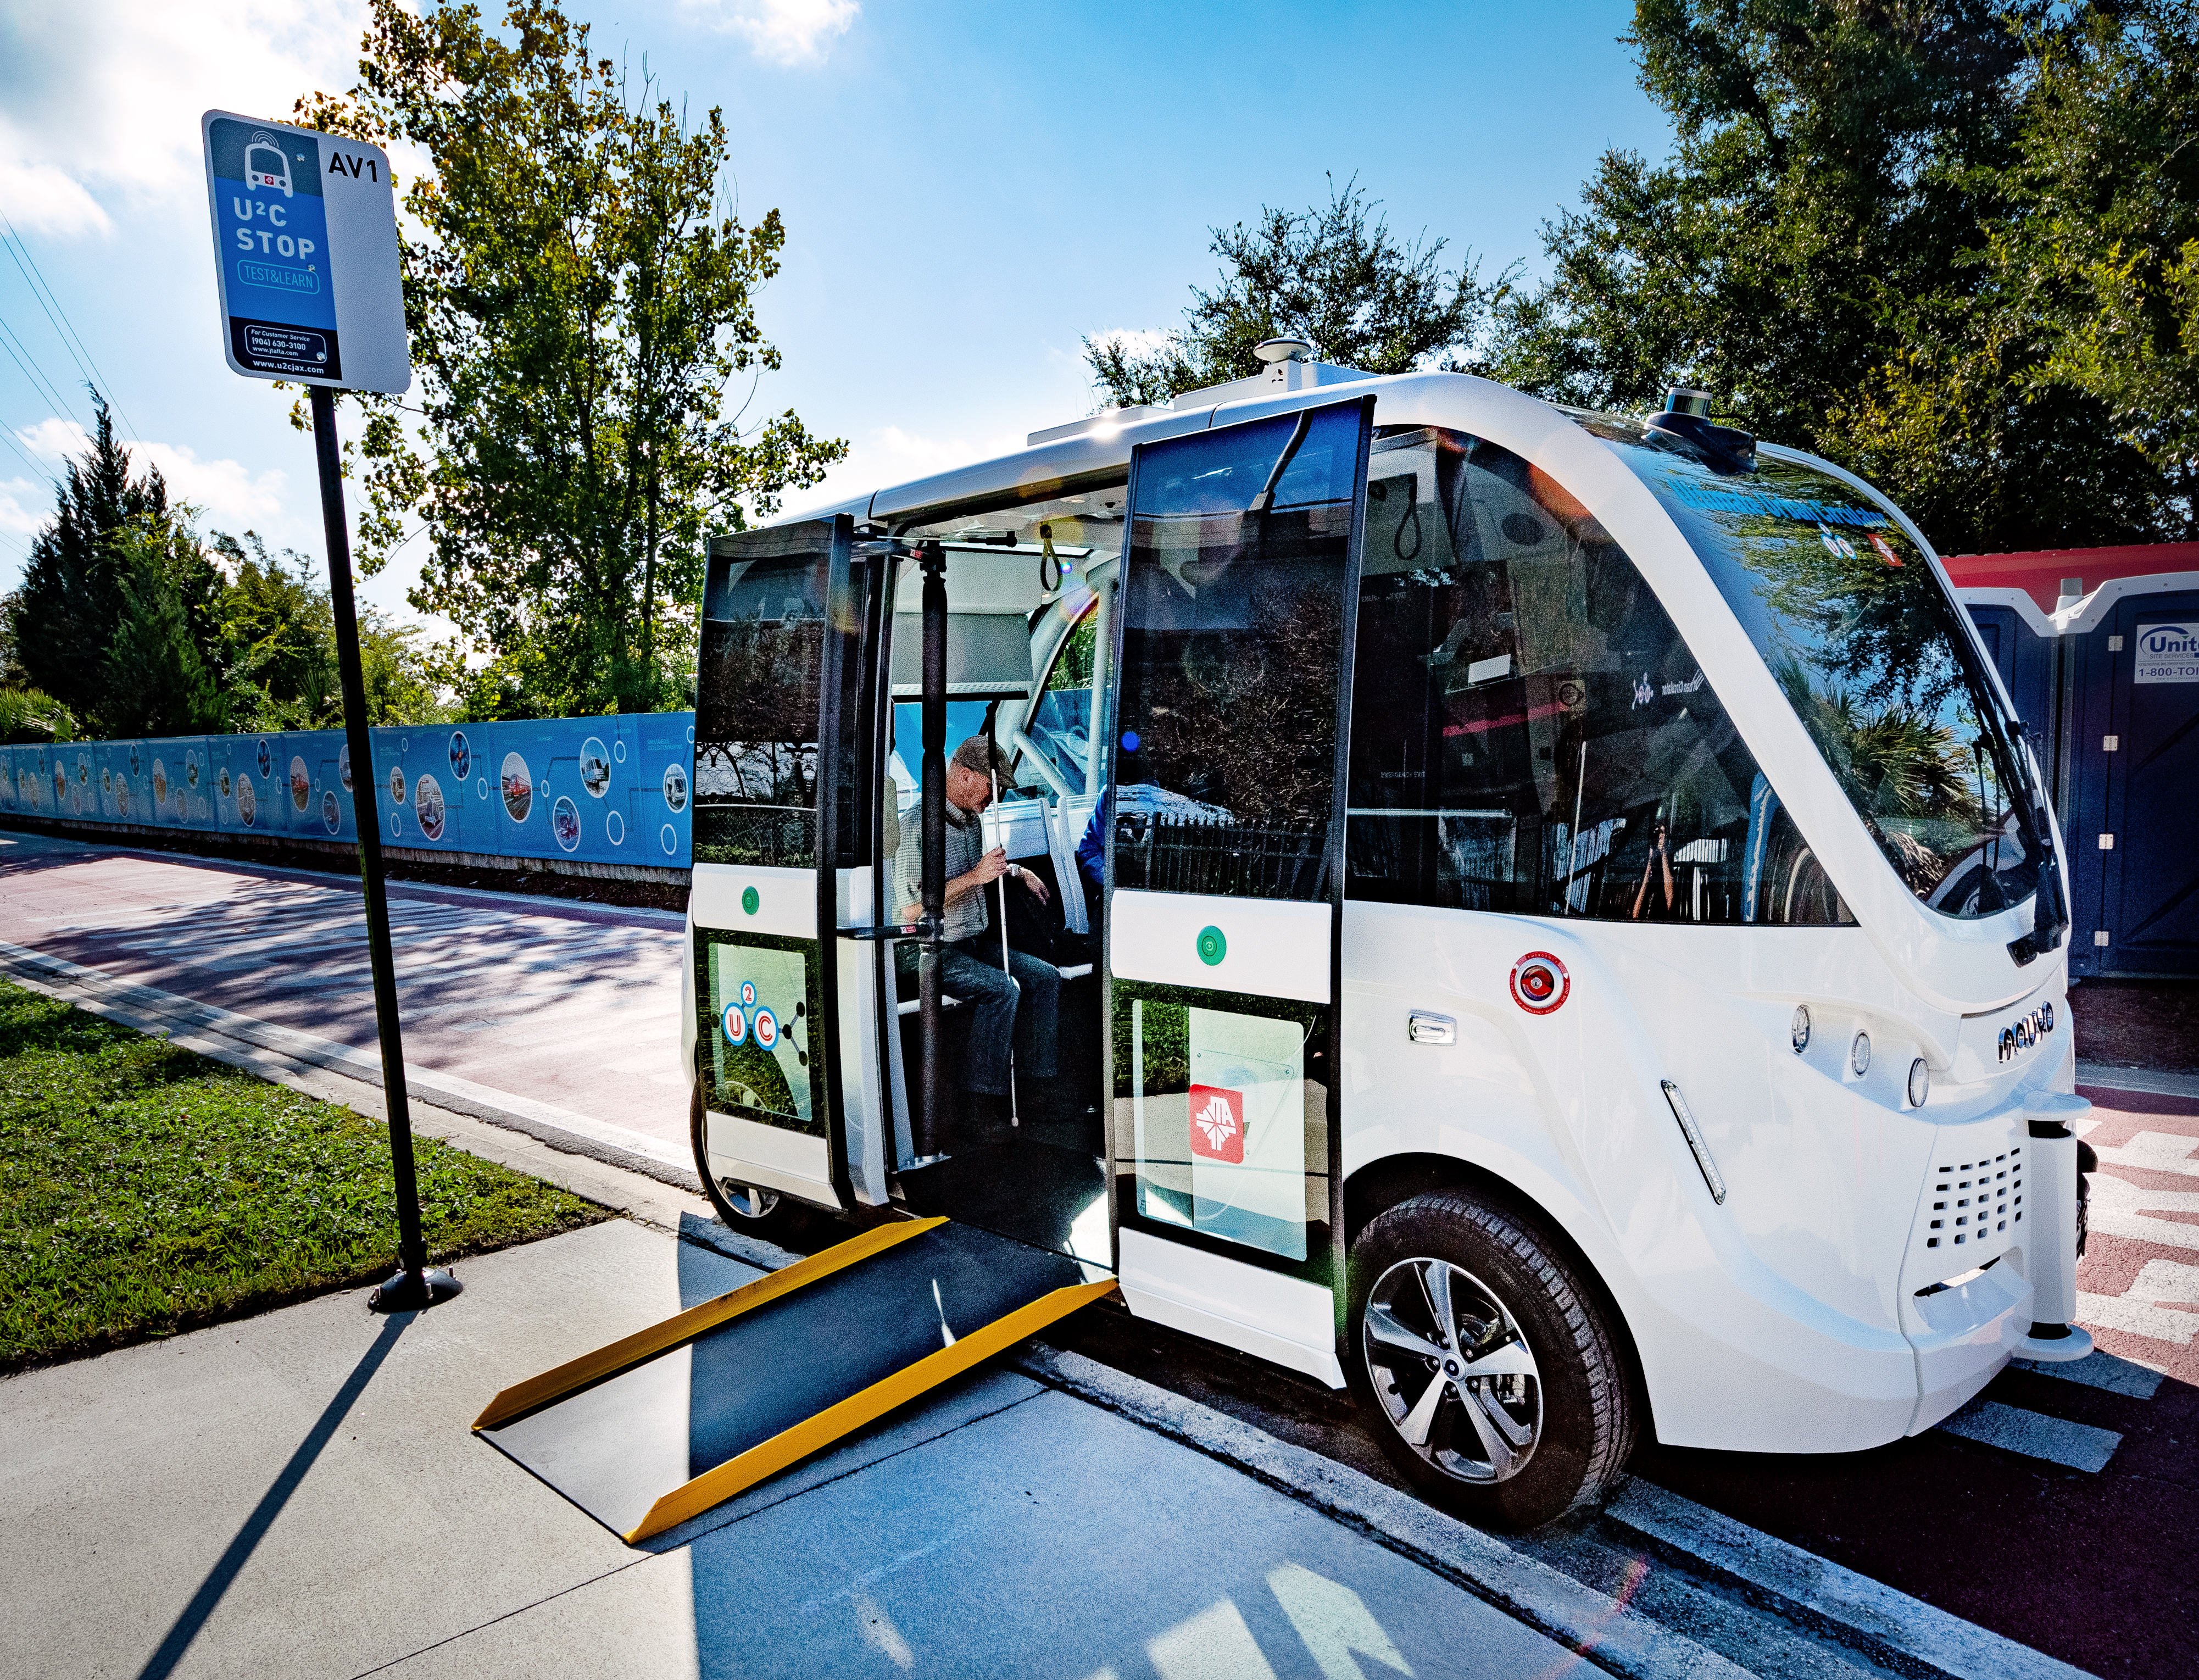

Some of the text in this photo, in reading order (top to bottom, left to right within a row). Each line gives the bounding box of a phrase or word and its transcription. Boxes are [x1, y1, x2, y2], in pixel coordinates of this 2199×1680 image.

[328, 152, 378, 183] AV1
[236, 227, 315, 260] STOP
[244, 265, 314, 289] TEST&LEARN
[252, 337, 306, 351] (904) 630-3100
[261, 331, 289, 339] Customer
[252, 360, 324, 374] www.u2cjax.com
[1753, 493, 1822, 522] Urban
[1808, 499, 1892, 529] Circulator
[2150, 635, 2199, 653] Unit
